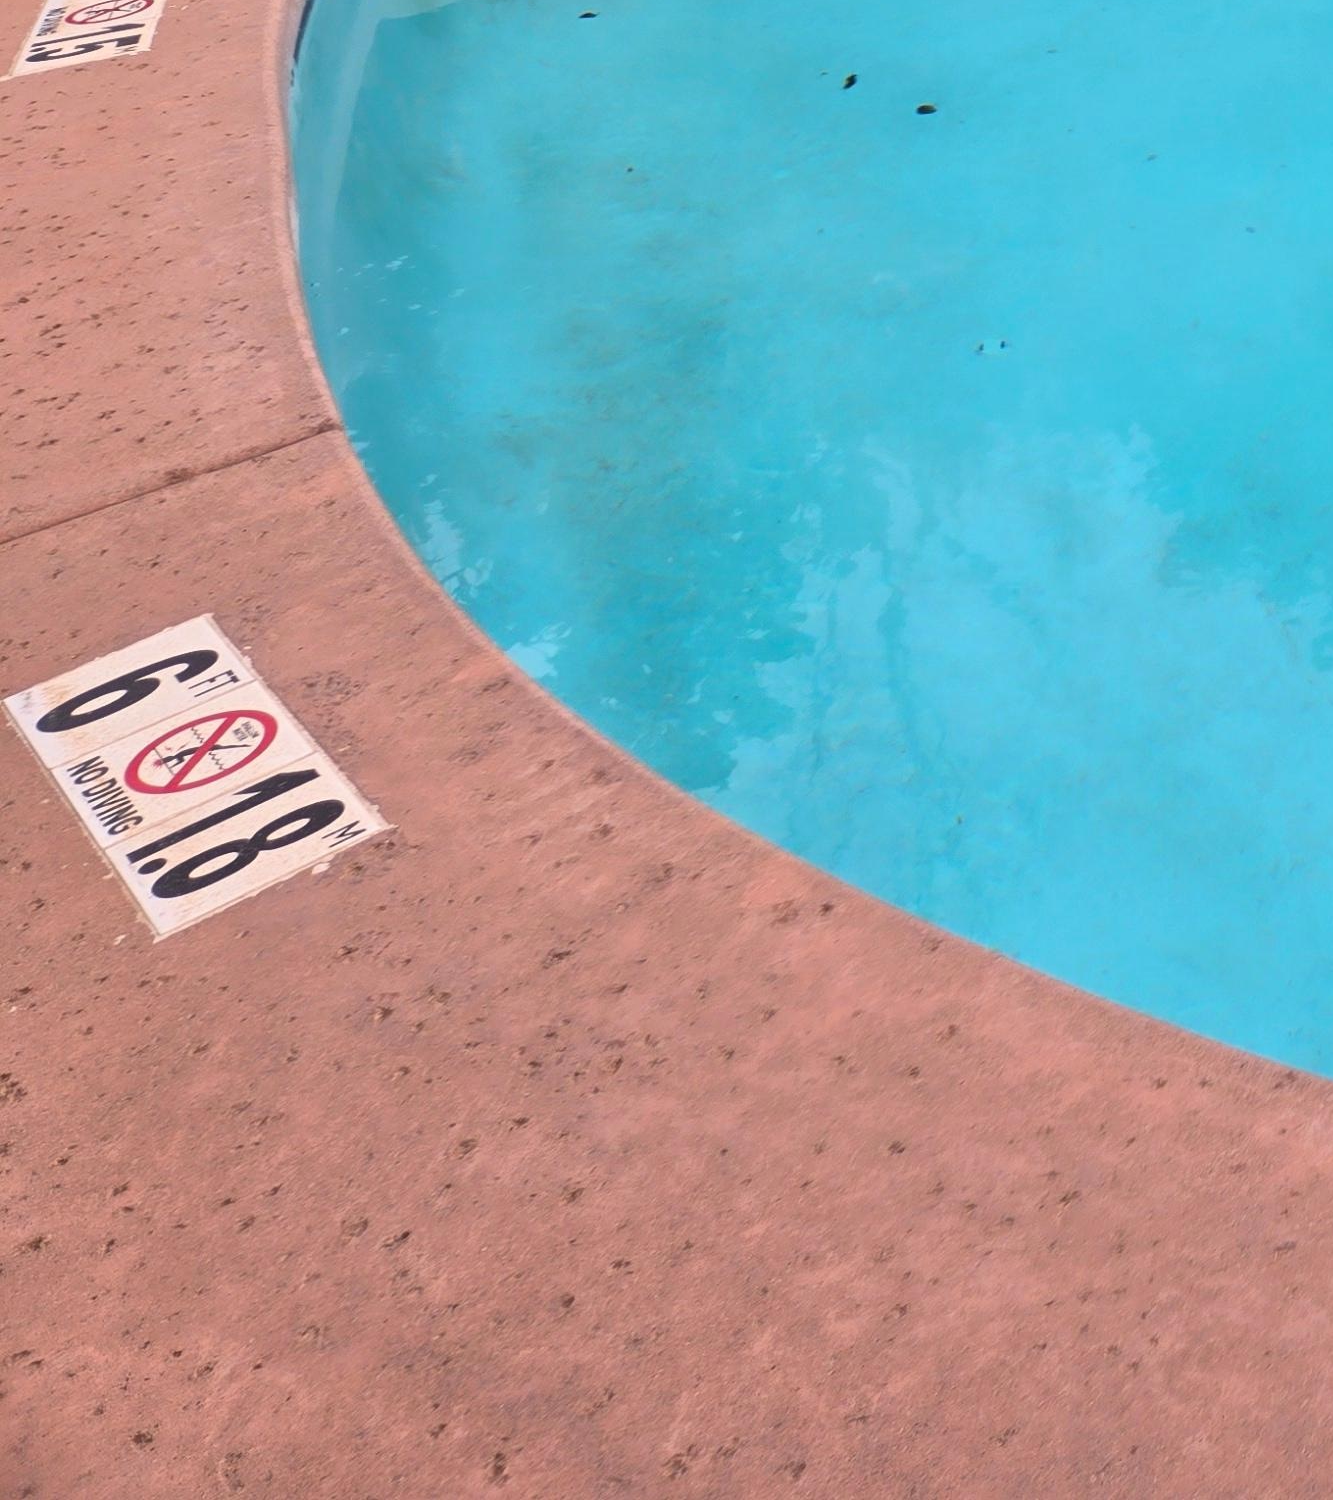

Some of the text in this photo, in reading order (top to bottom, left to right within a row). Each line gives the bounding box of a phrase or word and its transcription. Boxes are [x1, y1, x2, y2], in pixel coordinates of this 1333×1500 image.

[25, 23, 146, 62] 1.5
[36, 649, 243, 733] 6 FT
[66, 755, 145, 836] NO DIVING
[126, 768, 368, 899] 1.8 M
